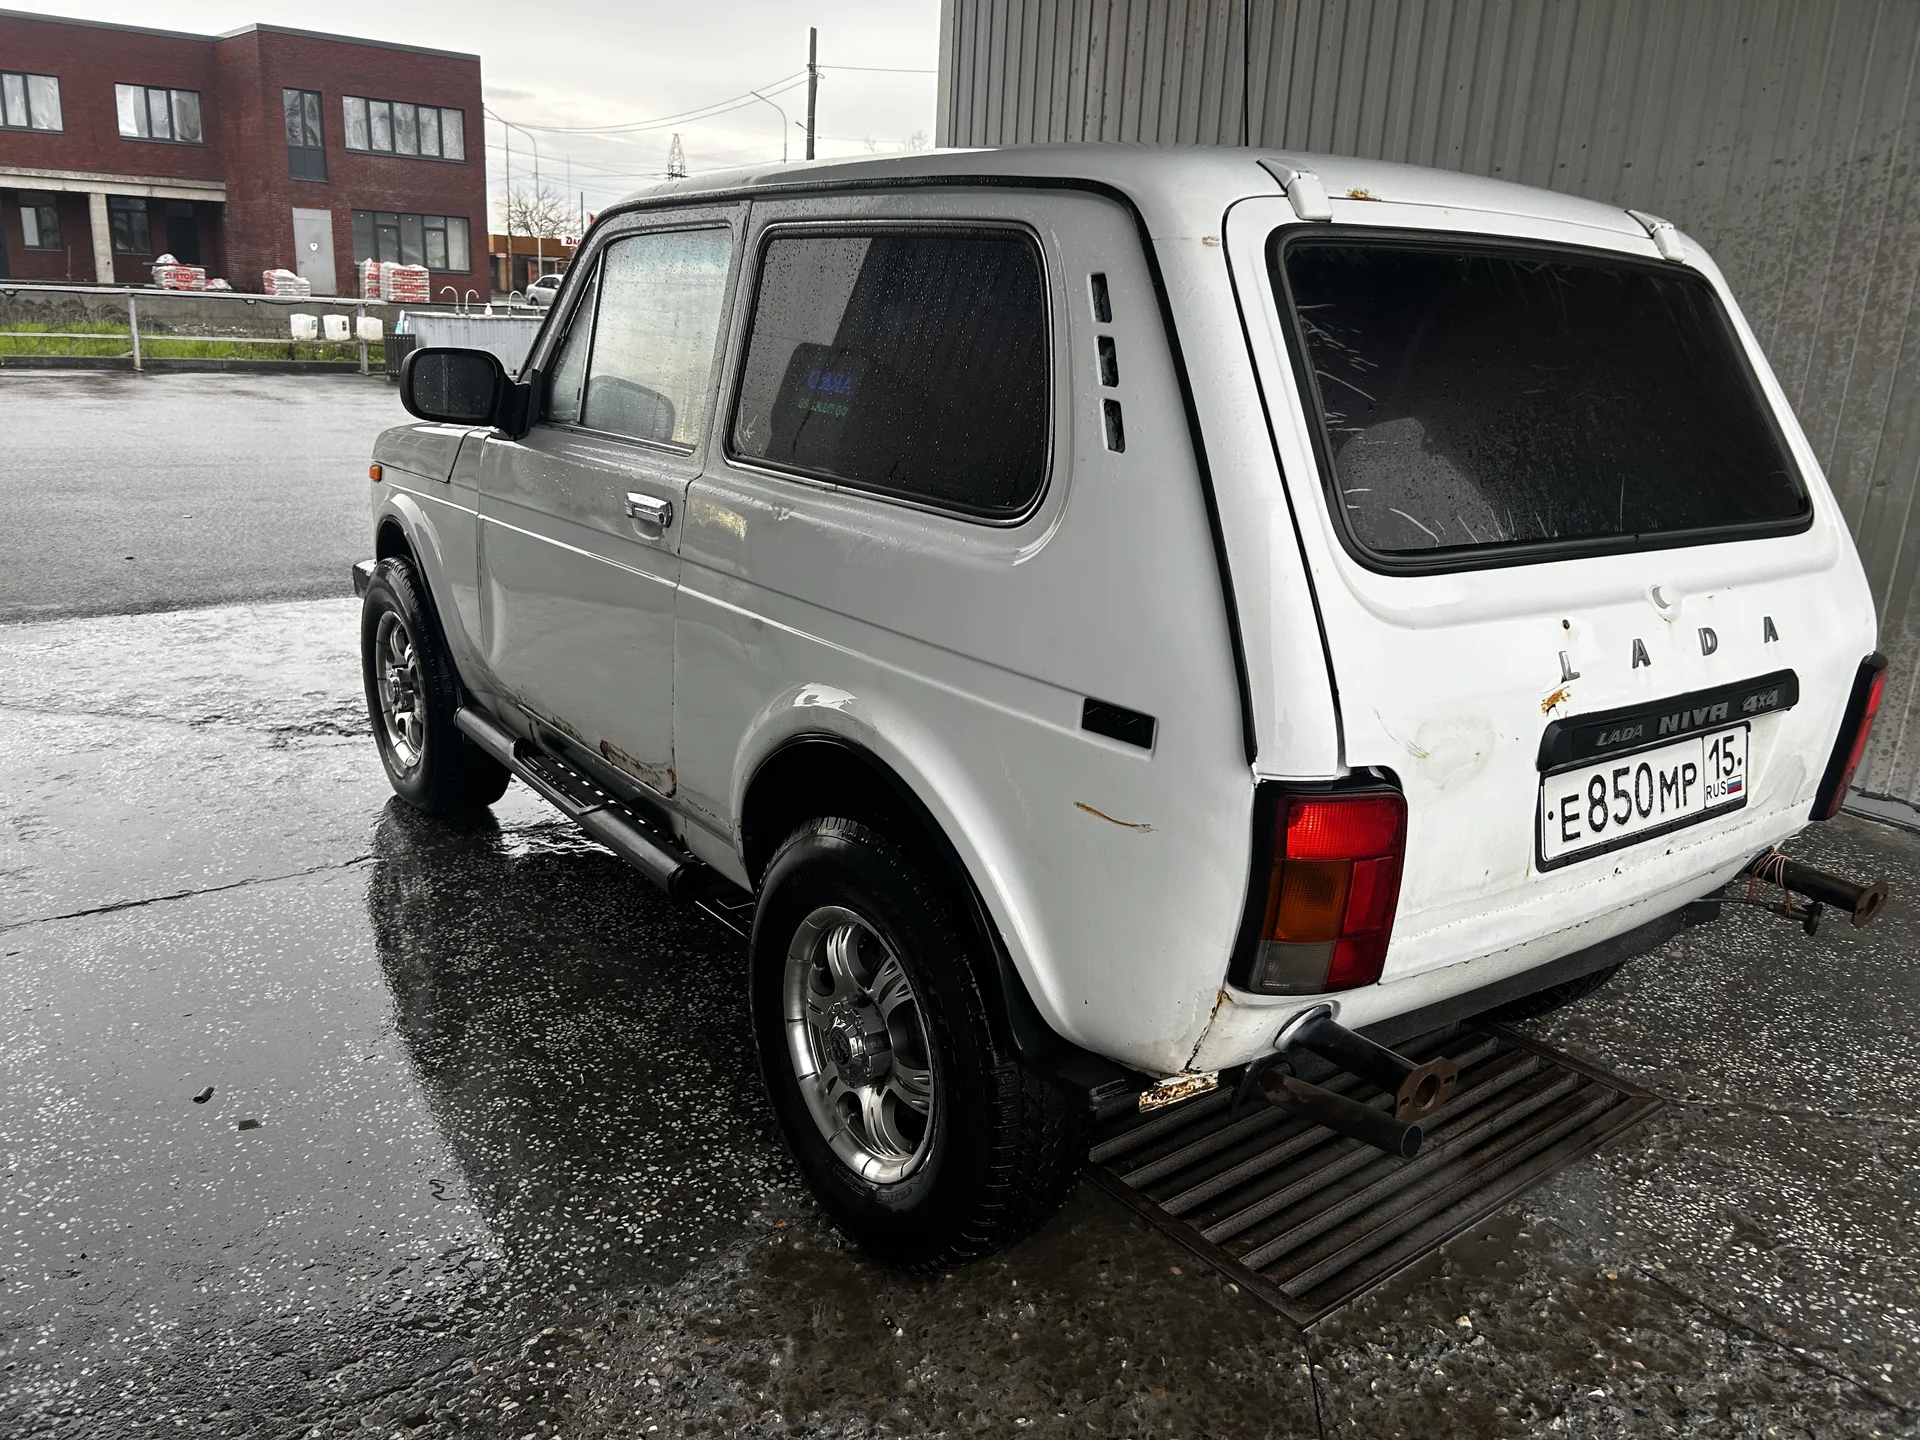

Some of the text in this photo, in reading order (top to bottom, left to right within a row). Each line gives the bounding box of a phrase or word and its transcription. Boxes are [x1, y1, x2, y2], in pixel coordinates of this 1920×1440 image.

[1558, 615, 1779, 681] LADA
[1595, 723, 1643, 748] LADA
[1658, 701, 1729, 735] NIVA
[1560, 735, 1735, 843] Е850МР 15
[1705, 780, 1727, 801] RUS
